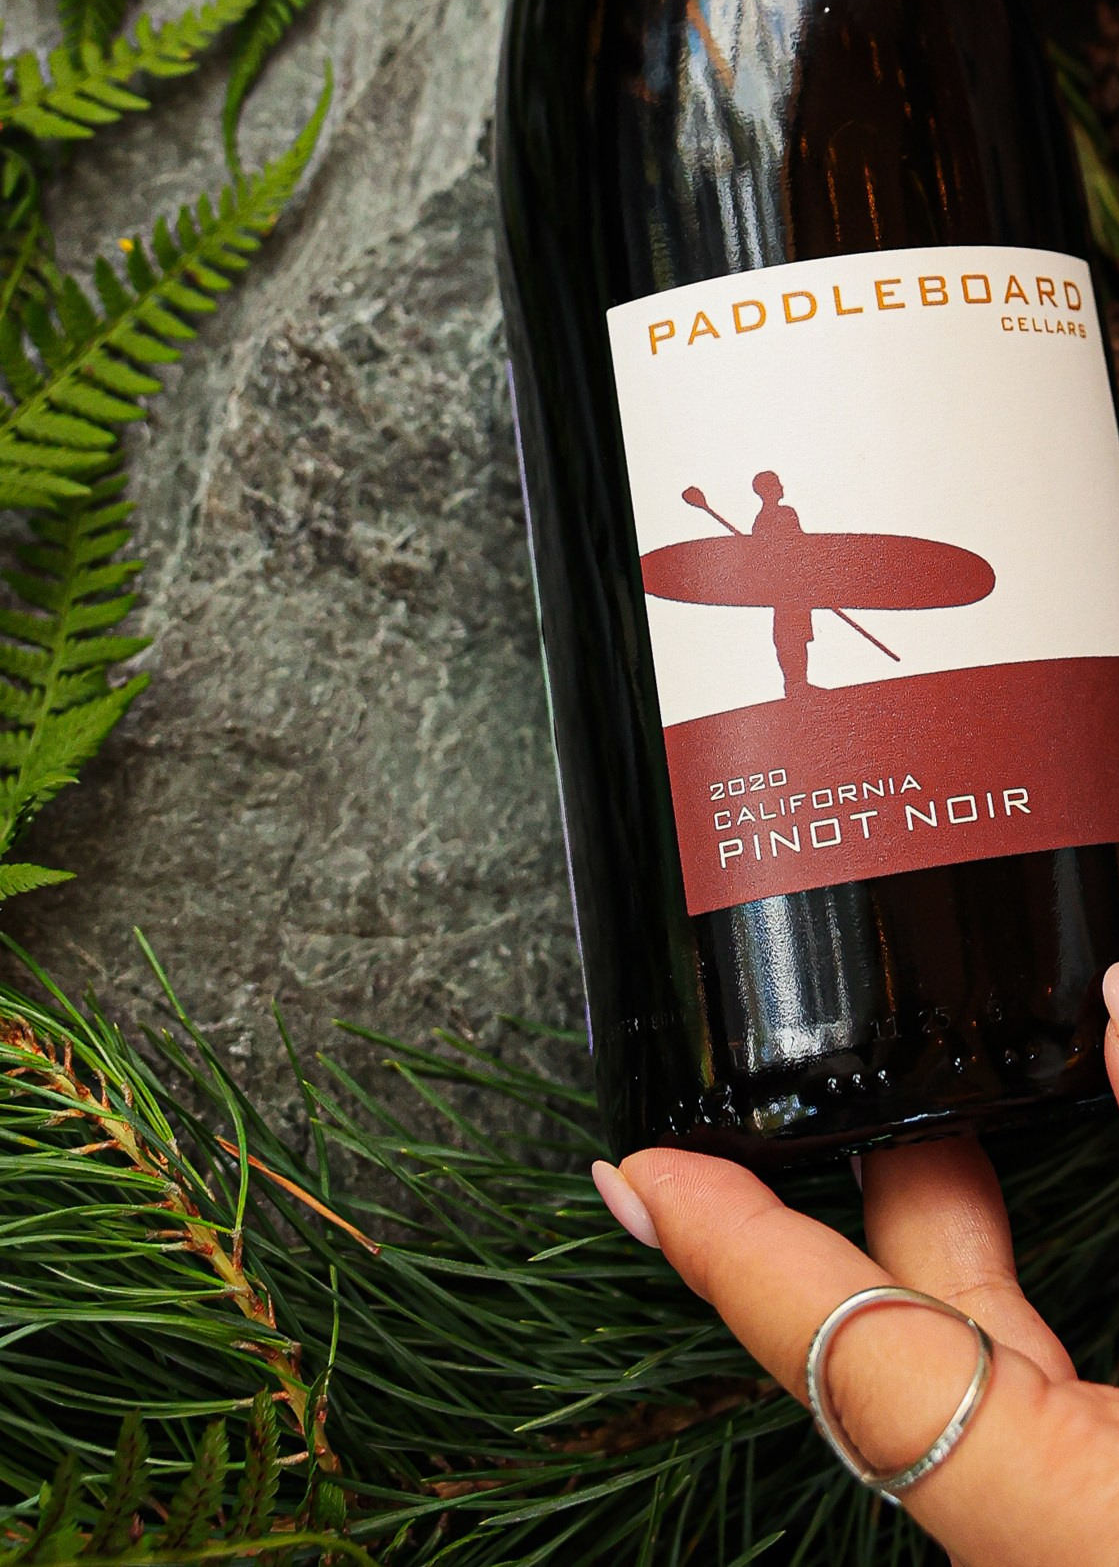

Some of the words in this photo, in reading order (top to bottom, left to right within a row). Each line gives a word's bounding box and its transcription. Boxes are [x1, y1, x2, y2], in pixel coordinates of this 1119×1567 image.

[648, 272, 1083, 355] PADDLEBOARD
[1000, 315, 1088, 339] CELLARS
[709, 768, 788, 801] 2020
[713, 774, 922, 831] CALIFORNIA
[718, 810, 878, 869] PINOT
[904, 787, 1031, 831] NOIR
